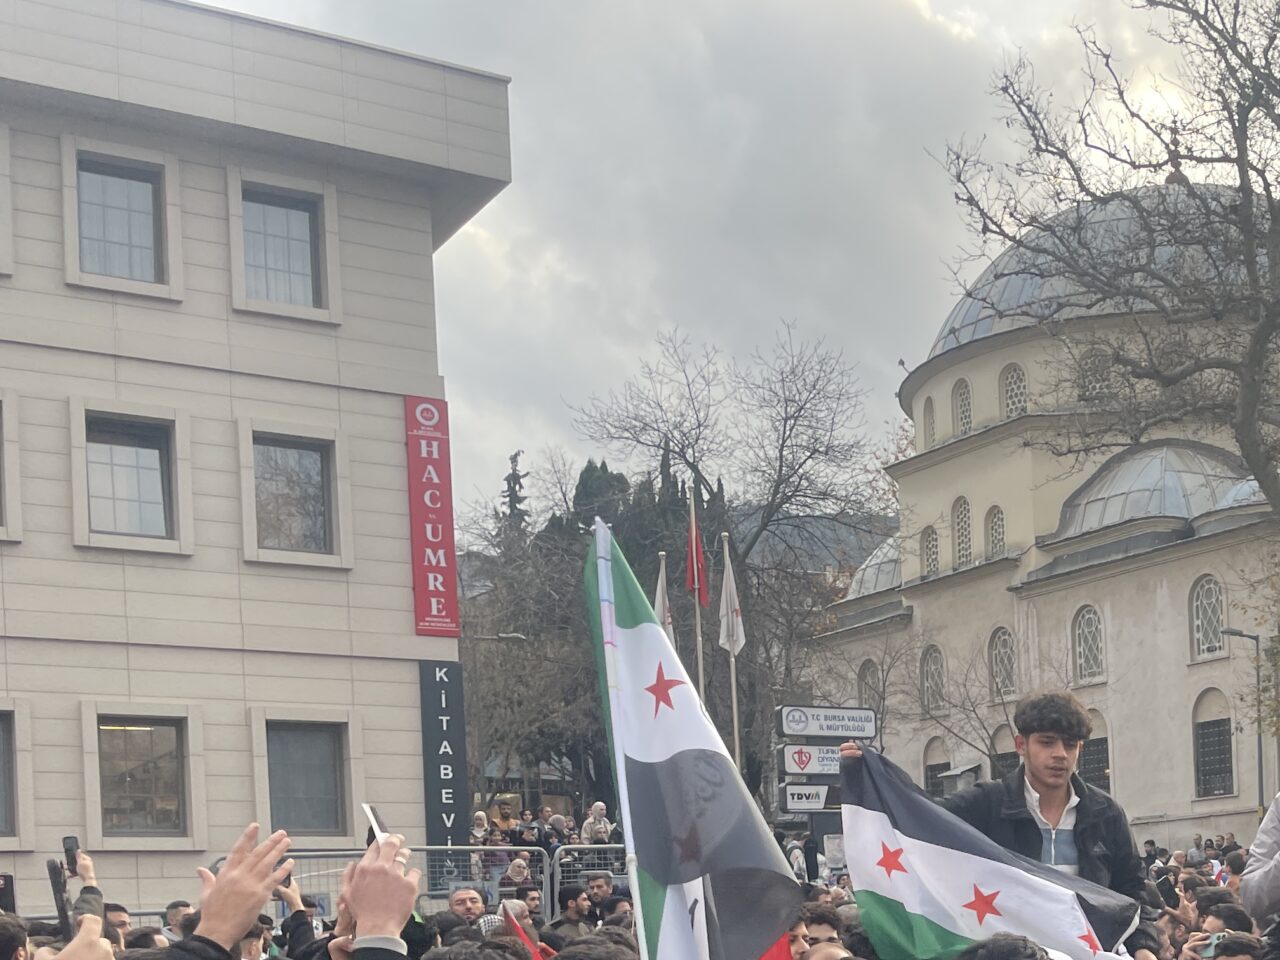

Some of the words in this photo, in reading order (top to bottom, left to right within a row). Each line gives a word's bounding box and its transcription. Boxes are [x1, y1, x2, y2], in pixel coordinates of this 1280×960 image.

[420, 440, 441, 508] HAC
[424, 523, 447, 616] UMRE
[824, 714, 845, 722] BURSA
[435, 667, 455, 853] KİTABEVİ
